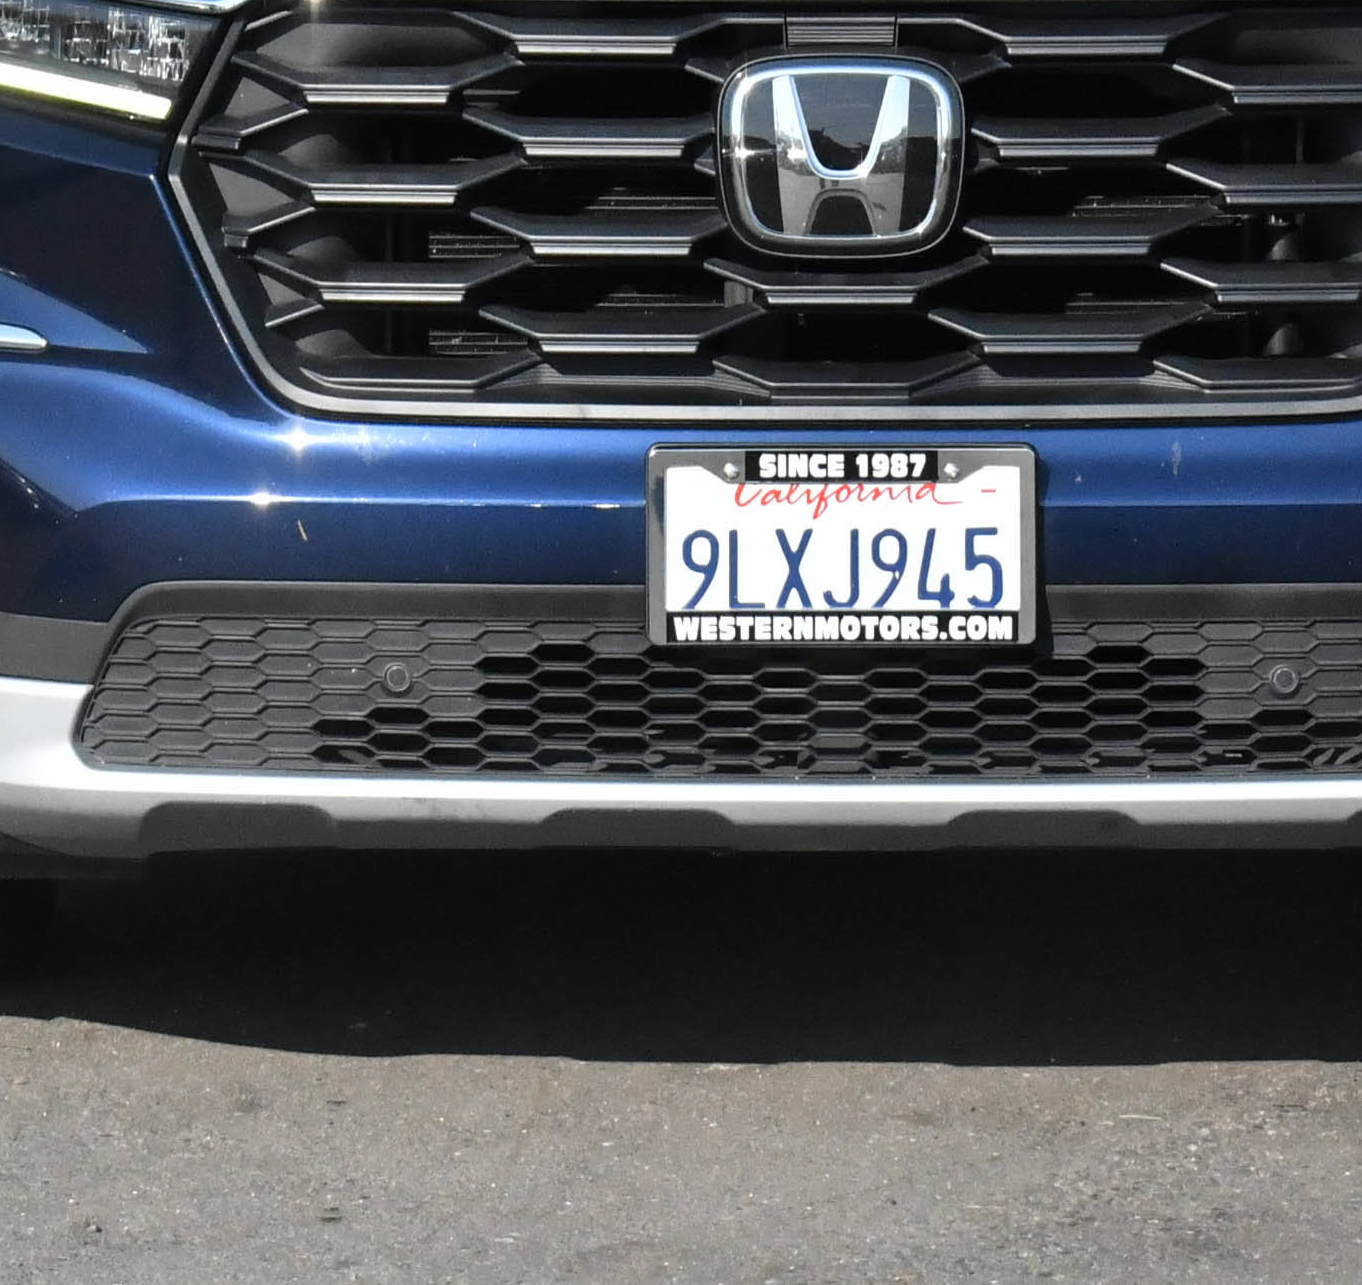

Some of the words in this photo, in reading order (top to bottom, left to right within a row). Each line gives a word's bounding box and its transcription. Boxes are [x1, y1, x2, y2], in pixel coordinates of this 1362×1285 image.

[759, 453, 846, 479] SINCE
[855, 453, 927, 478] 1987
[682, 527, 1004, 610] 9LXJ945
[673, 615, 1014, 642] WESTERNMOTORS.COM
